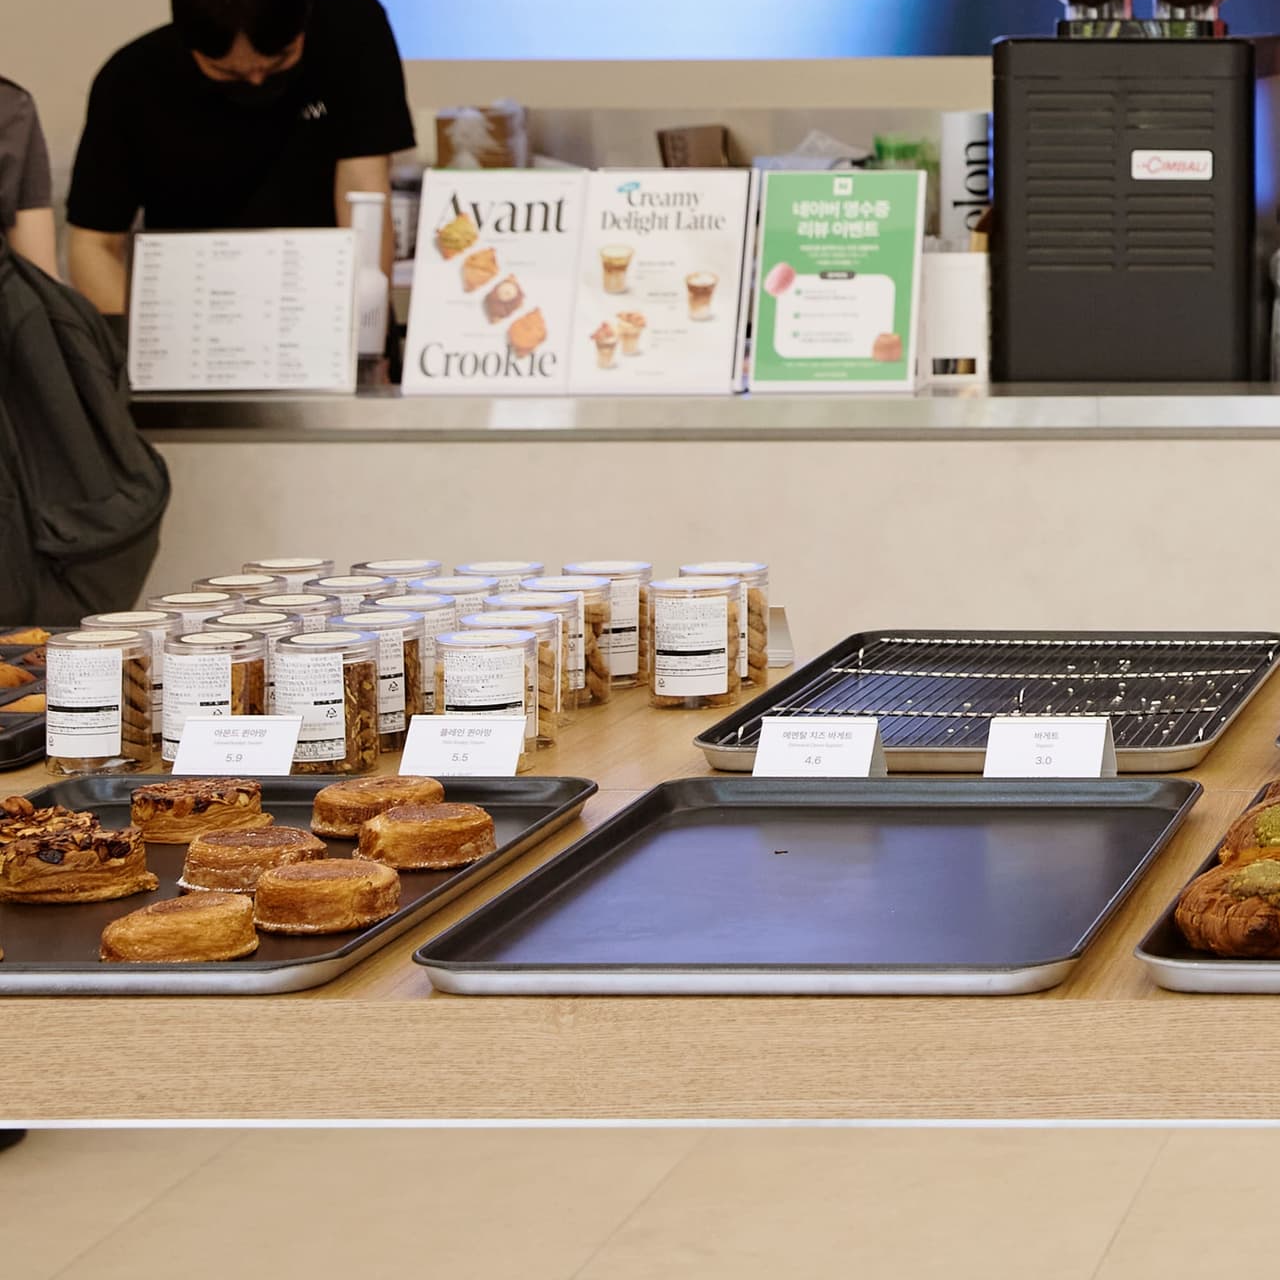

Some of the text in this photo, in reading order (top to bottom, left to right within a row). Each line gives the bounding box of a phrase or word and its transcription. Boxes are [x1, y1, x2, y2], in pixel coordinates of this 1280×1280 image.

[435, 190, 568, 233] Avant
[600, 211, 727, 235] Delight Latte
[797, 221, 880, 239] 리뷰 이벤트
[419, 341, 557, 378] Crookie
[214, 728, 239, 737] 아몬드
[810, 731, 826, 740] 치즈
[828, 731, 853, 740] 바게트
[1034, 731, 1059, 740] 바게트
[225, 753, 243, 762] 5.9
[451, 753, 469, 762] 5.5
[804, 755, 822, 765] 4.6
[1035, 755, 1053, 765] 3.0
